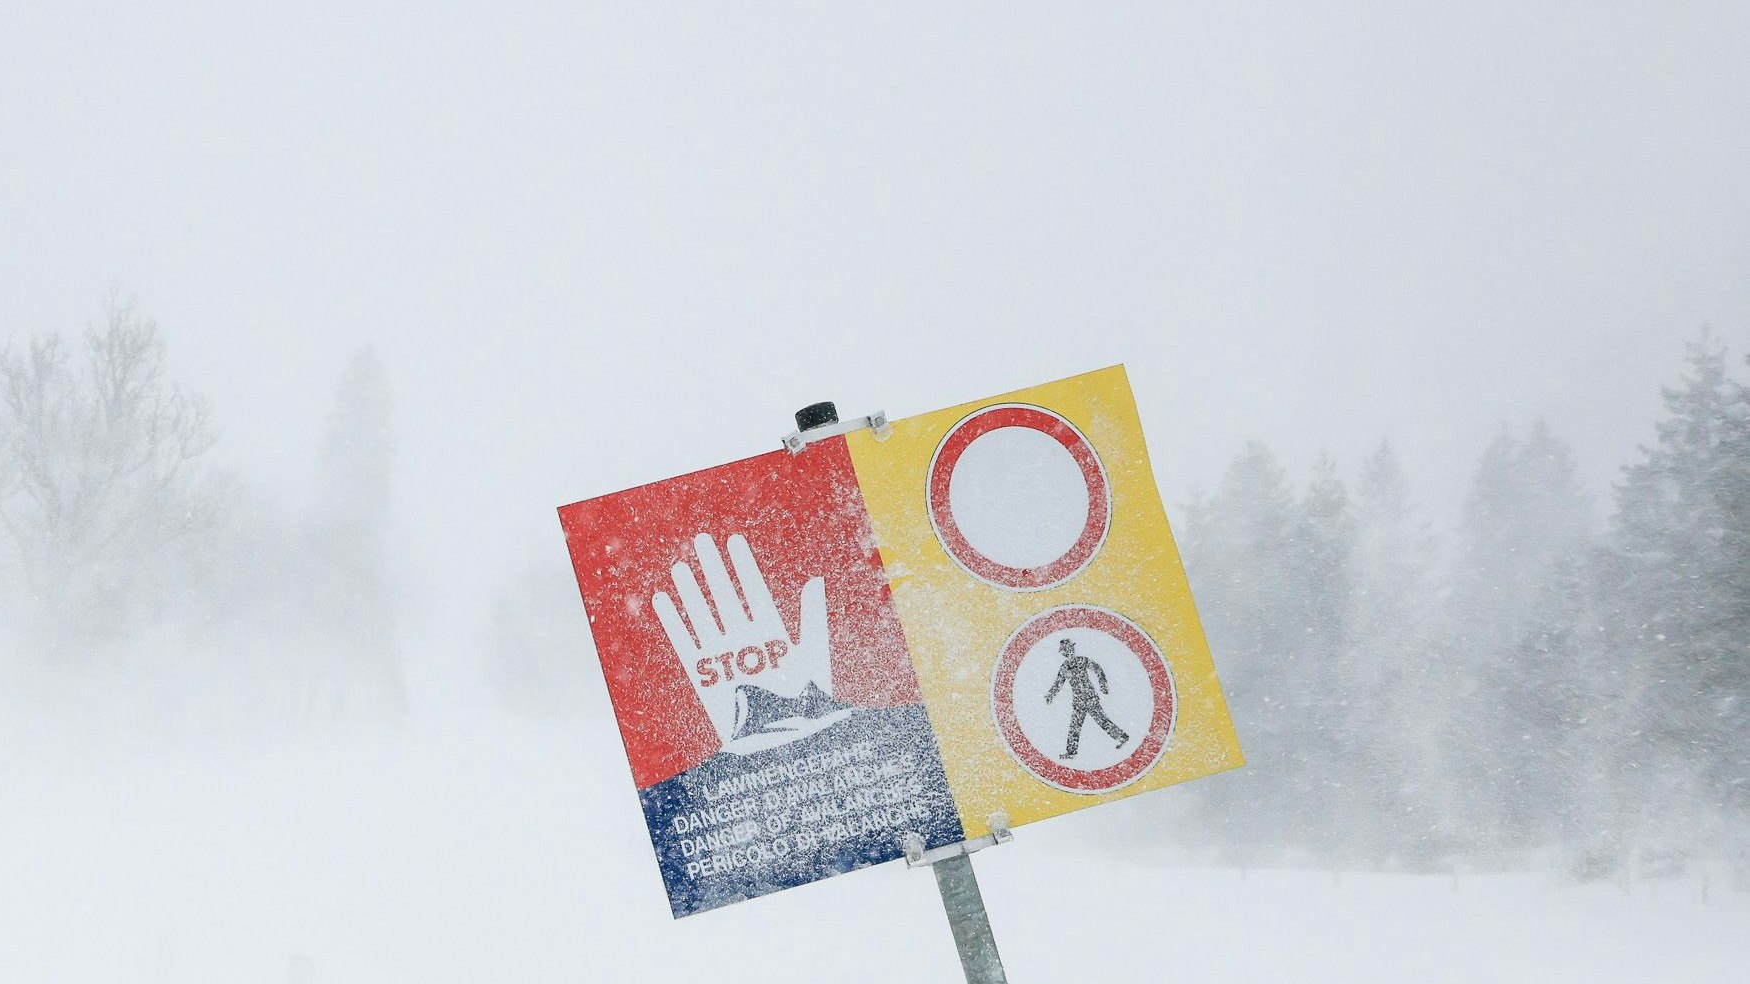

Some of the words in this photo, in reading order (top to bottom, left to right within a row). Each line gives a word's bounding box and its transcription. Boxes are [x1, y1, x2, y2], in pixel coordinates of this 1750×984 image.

[696, 639, 788, 688] STOP
[672, 796, 759, 835] DANGER
[679, 820, 761, 857] DANGER
[765, 812, 792, 834] OF
[798, 777, 923, 825] AVALANCHES
[686, 837, 791, 880] PERICOLO
[795, 829, 818, 851] DI
